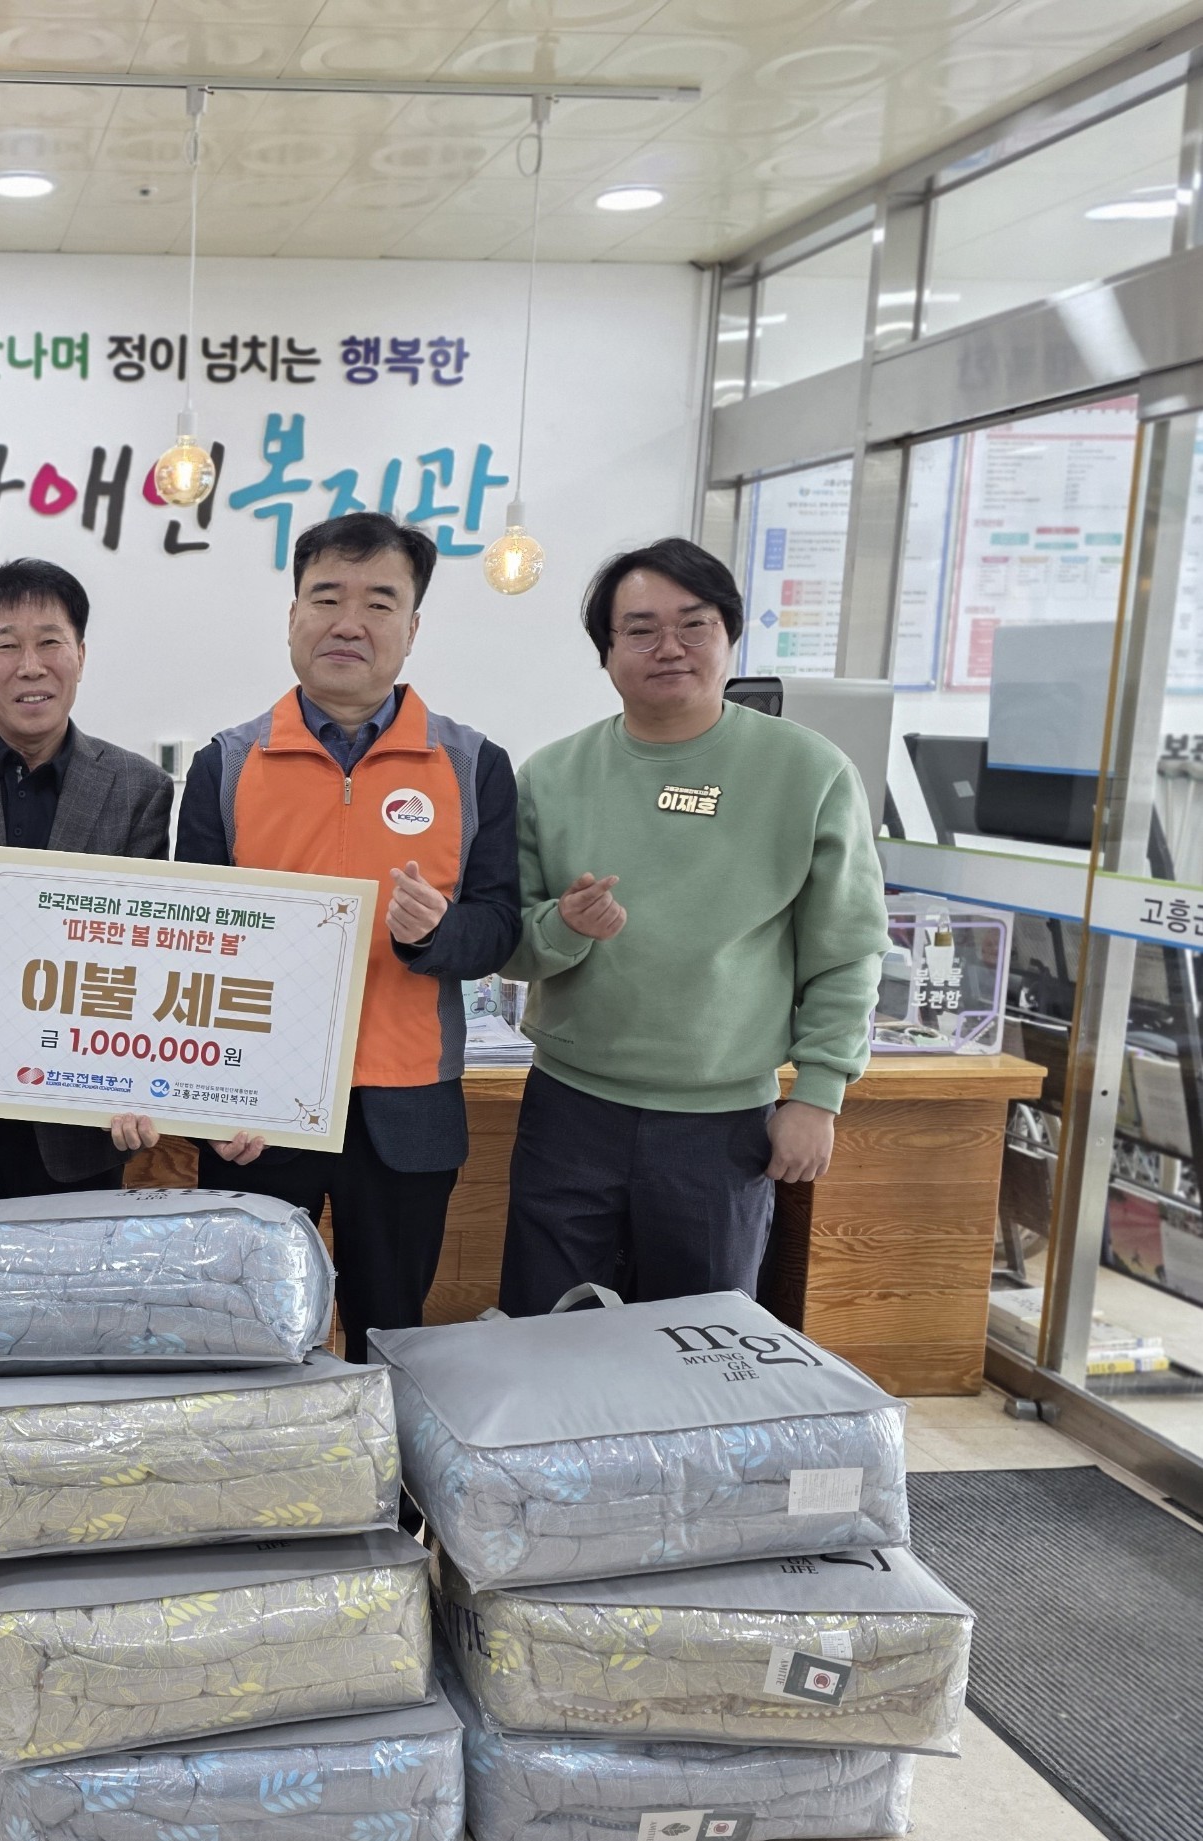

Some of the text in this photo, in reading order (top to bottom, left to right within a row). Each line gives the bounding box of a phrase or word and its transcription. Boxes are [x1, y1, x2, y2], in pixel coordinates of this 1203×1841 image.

[106, 333, 188, 384] 정이
[201, 333, 322, 385] 넘치는
[341, 335, 470, 386] 행복한
[38, 891, 276, 930] 한국전력공사 고흥군지사와 함께하는
[131, 924, 151, 948] 봄
[155, 926, 215, 954] 화사한
[21, 958, 275, 1034] 이불 세트
[911, 989, 962, 1010] 보관함
[40, 1029, 60, 1050] 금
[45, 1069, 134, 1089] 한국전력공사
[171, 1088, 259, 1107] 고흥군장애인복지관
[681, 1352, 745, 1366] MYUNG
[727, 1360, 753, 1371] GA
[722, 1369, 760, 1382] LIFE
[779, 1564, 819, 1574] LIFE
[787, 1556, 814, 1565] GA
